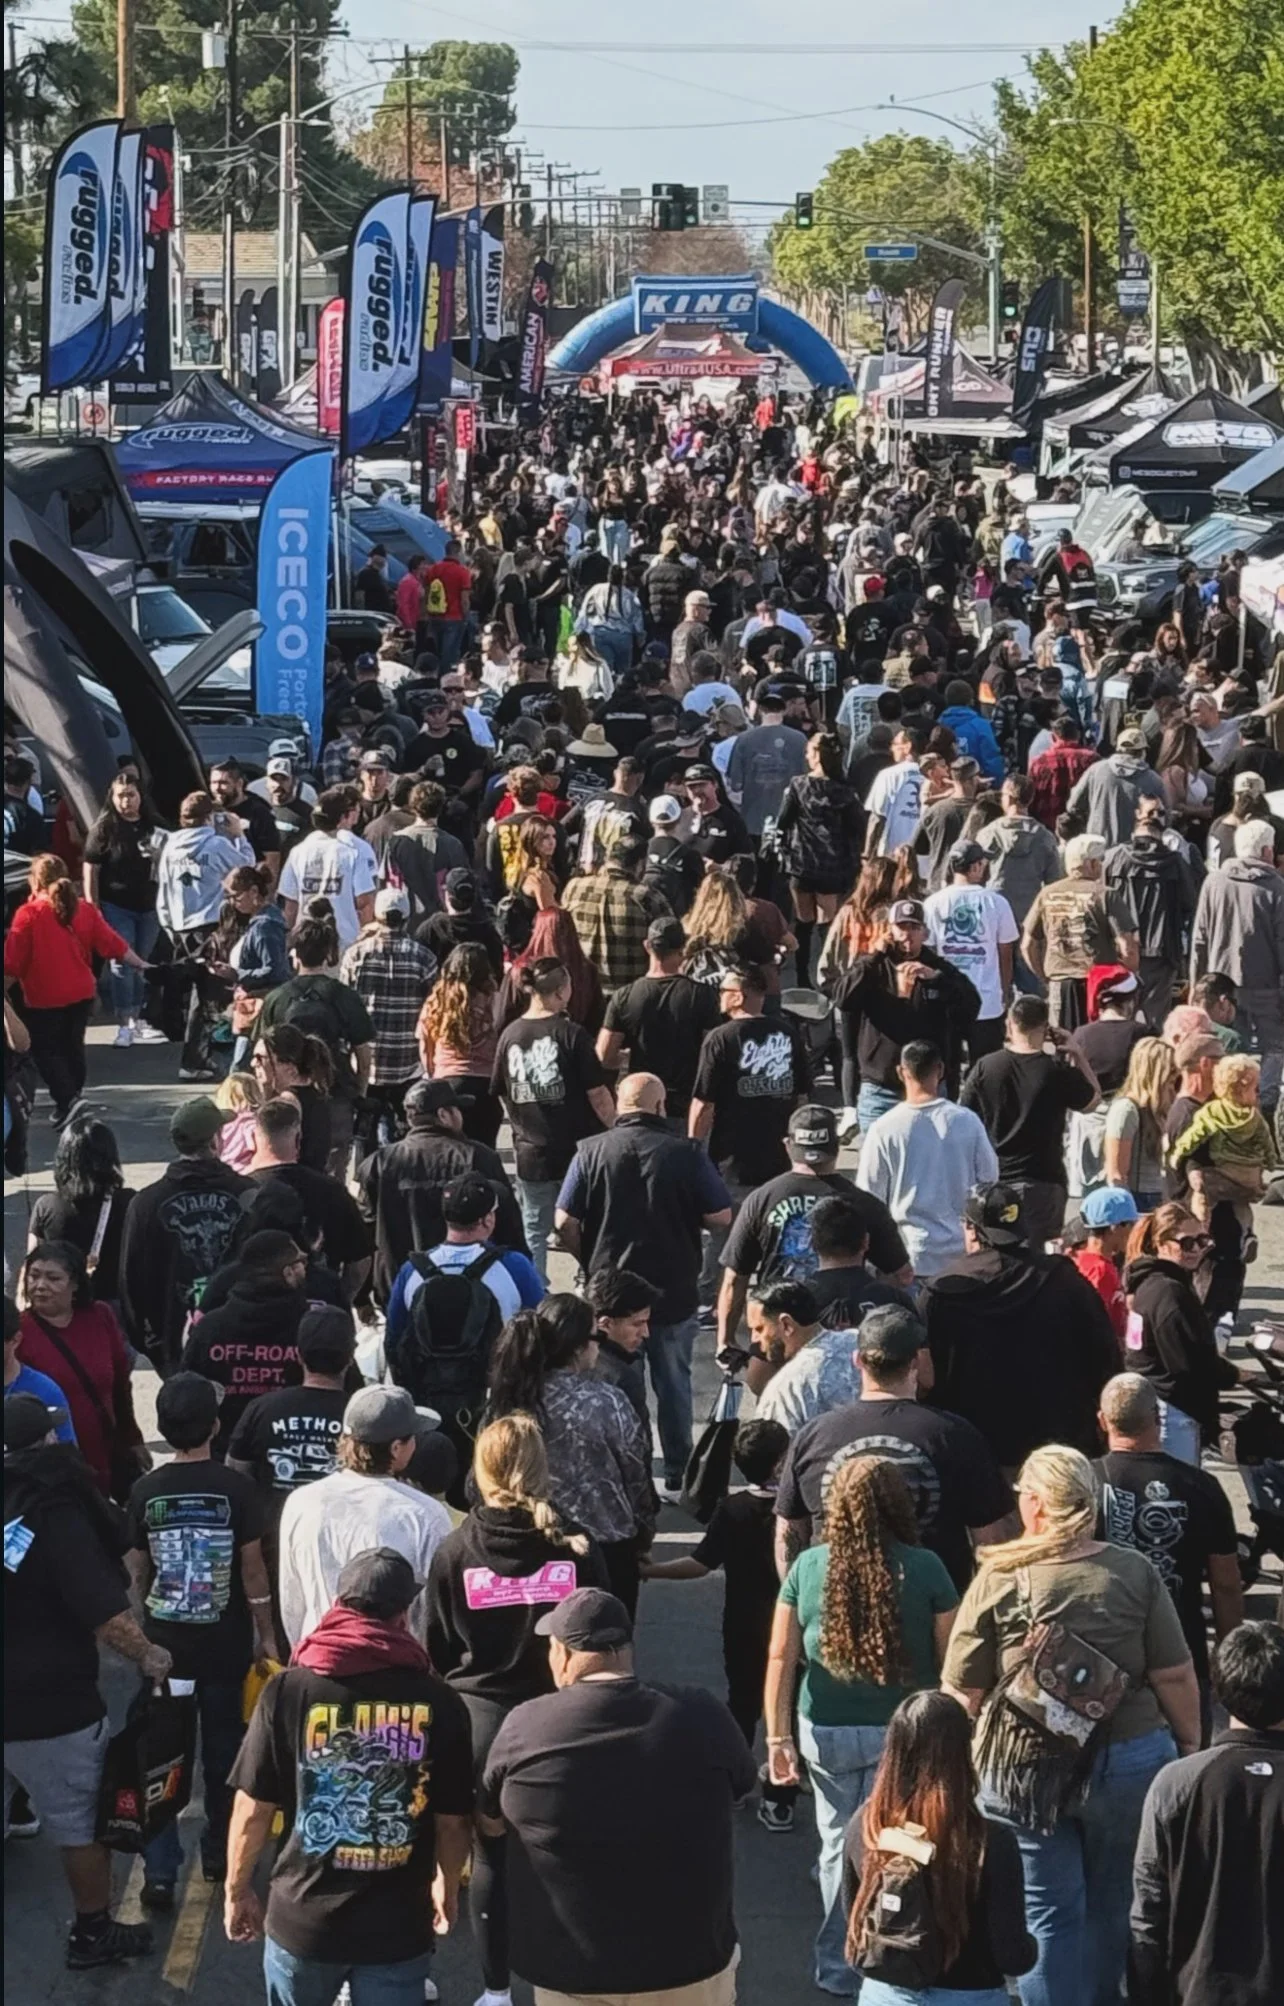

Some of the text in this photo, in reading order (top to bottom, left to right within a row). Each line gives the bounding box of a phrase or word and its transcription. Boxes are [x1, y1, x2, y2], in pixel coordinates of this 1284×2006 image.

[485, 251, 502, 325] WESTIN
[642, 294, 754, 313] KING
[519, 312, 542, 394] AMERICAN
[929, 306, 947, 378] RUNNER
[276, 508, 309, 661] ICECO
[278, 669, 292, 712] Free
[209, 1344, 300, 1361] OFF-ROA
[232, 1367, 286, 1384] DEPT.
[271, 1416, 342, 1435] METHO
